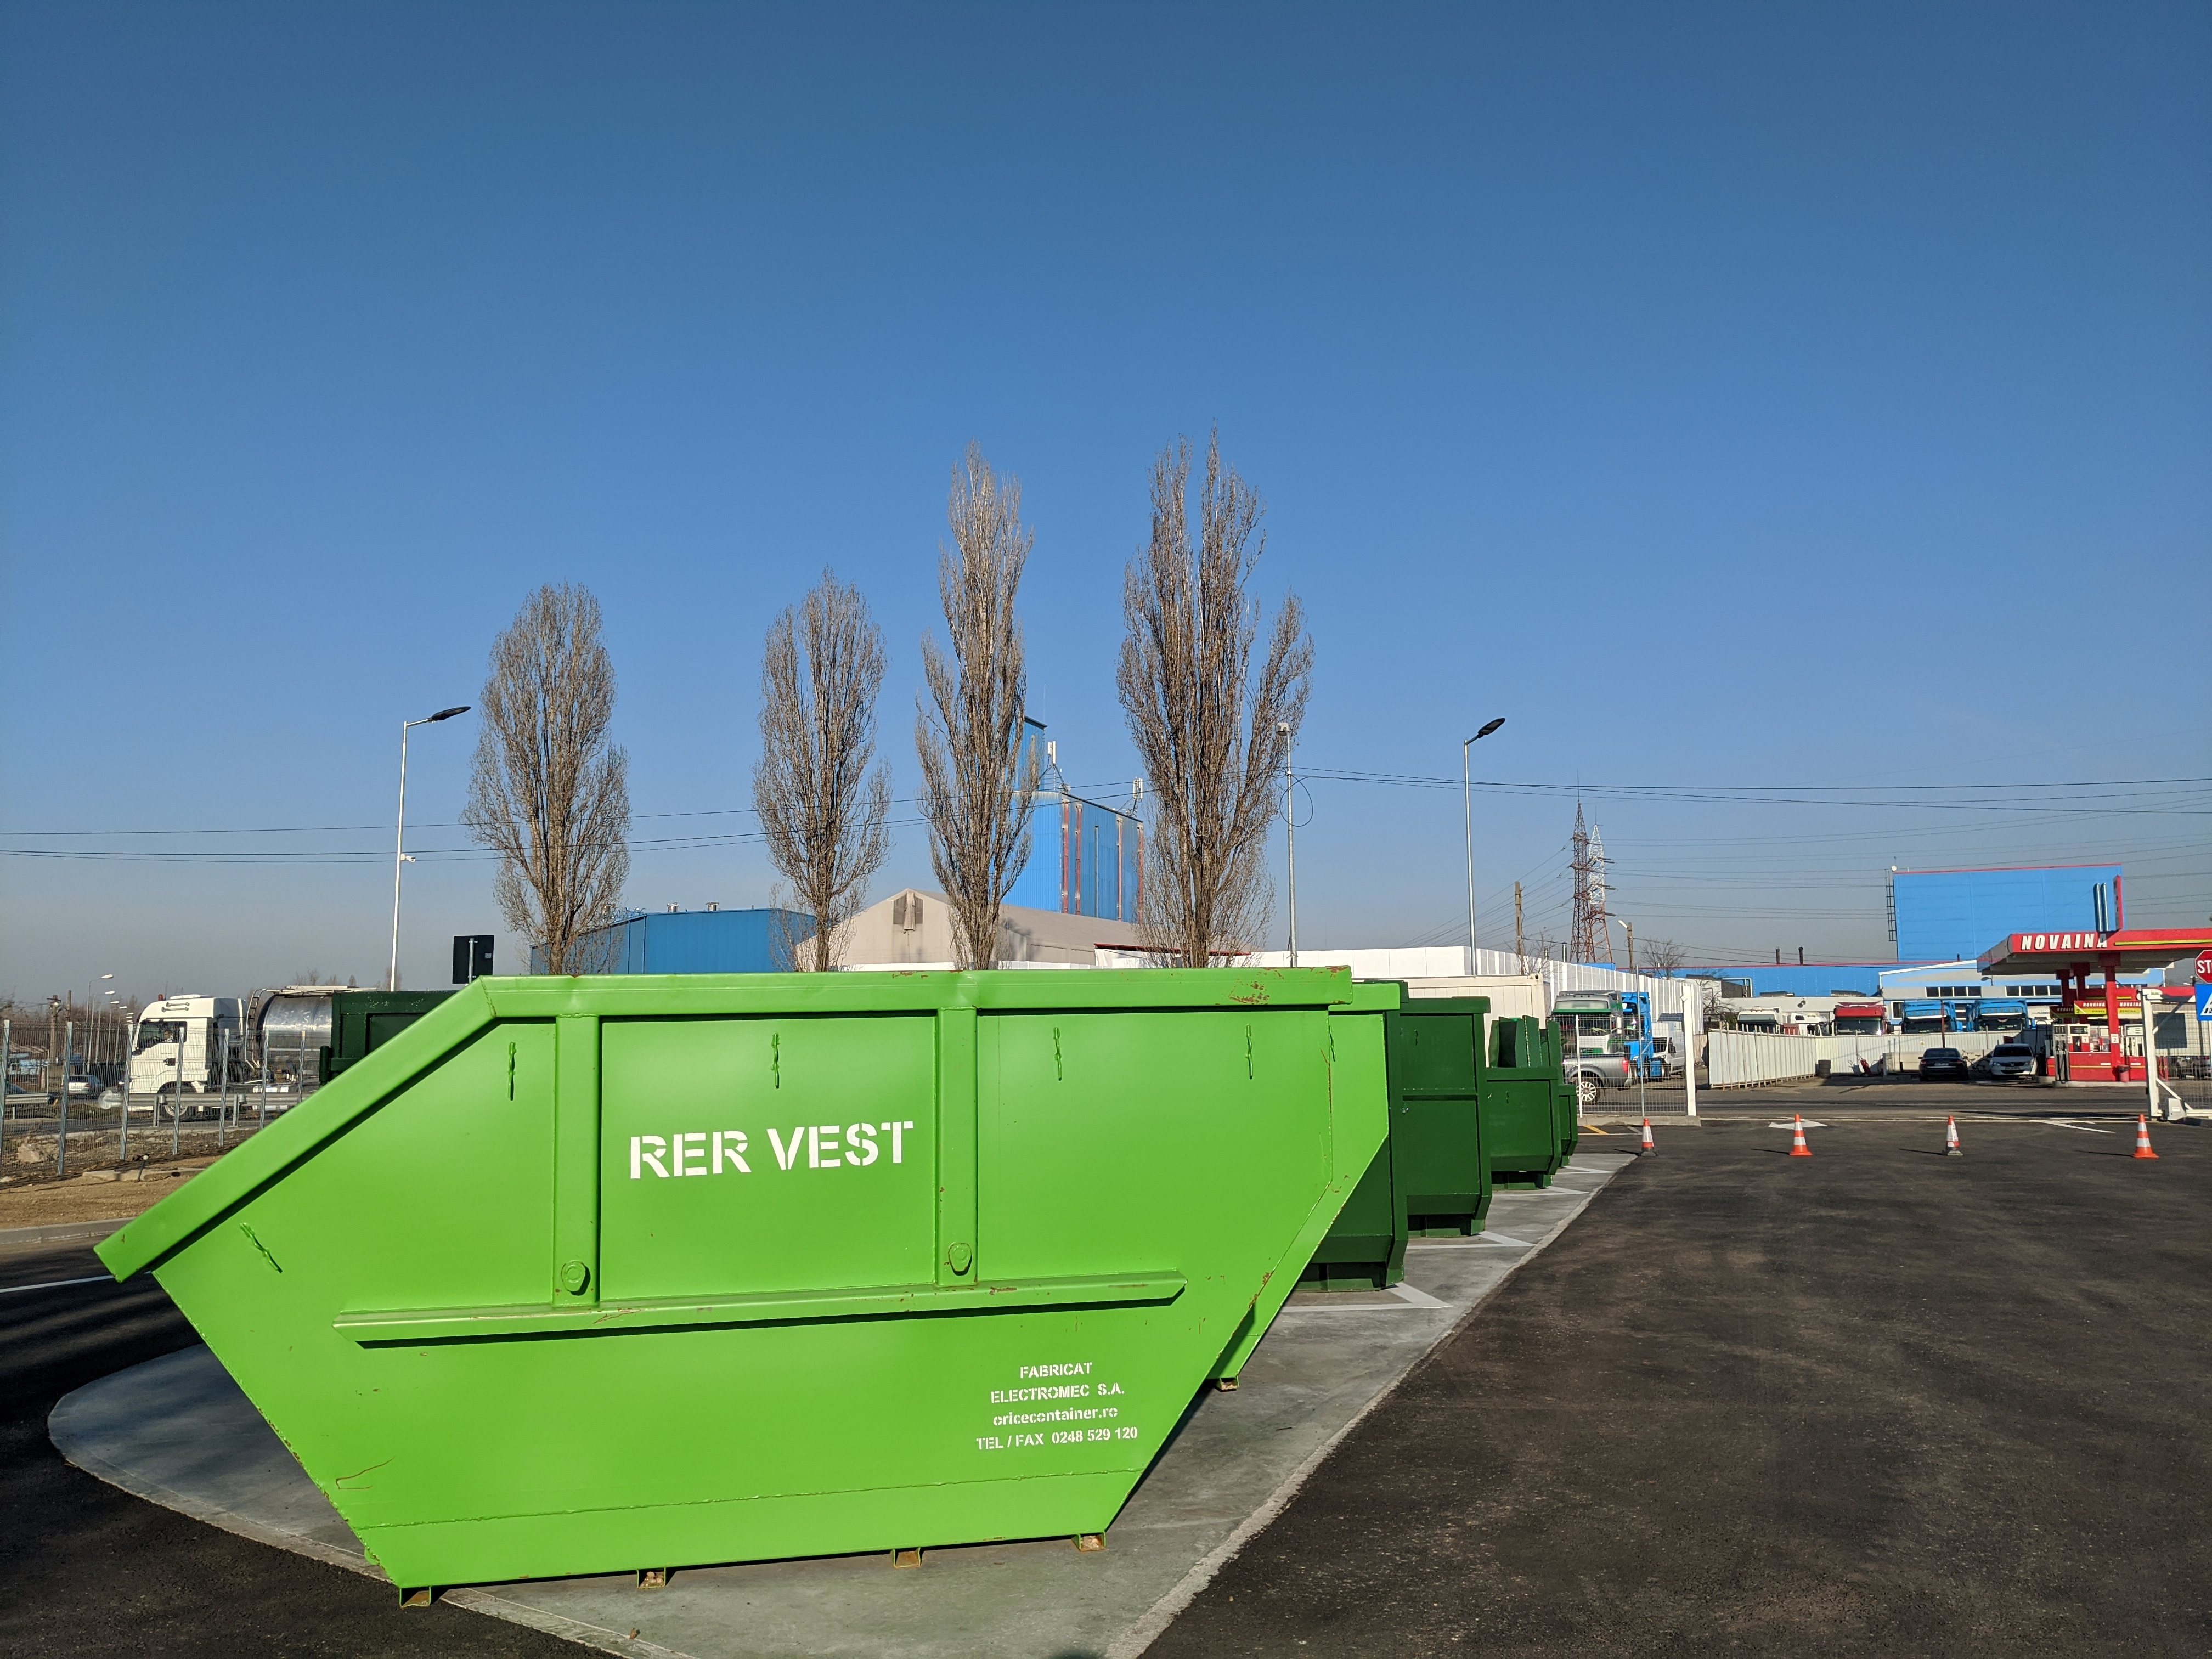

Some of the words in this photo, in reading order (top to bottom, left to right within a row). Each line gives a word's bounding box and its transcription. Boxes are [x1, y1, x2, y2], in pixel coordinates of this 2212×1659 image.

[2021, 933, 2107, 950] NOVAINA
[2197, 960, 2212, 974] ST
[630, 1131, 751, 1179] RER
[767, 1121, 913, 1170] VEST
[1020, 1362, 1092, 1378] FABRICAT
[991, 1385, 1089, 1403] ELECTROMEC
[1098, 1383, 1124, 1395] S.A.
[994, 1408, 1117, 1425] oricecontainer.ro
[976, 1437, 1003, 1449] TEL
[1016, 1434, 1043, 1447] FAX
[1052, 1430, 1083, 1443] 0248
[1088, 1429, 1110, 1441] 529
[1115, 1427, 1137, 1439] 120
